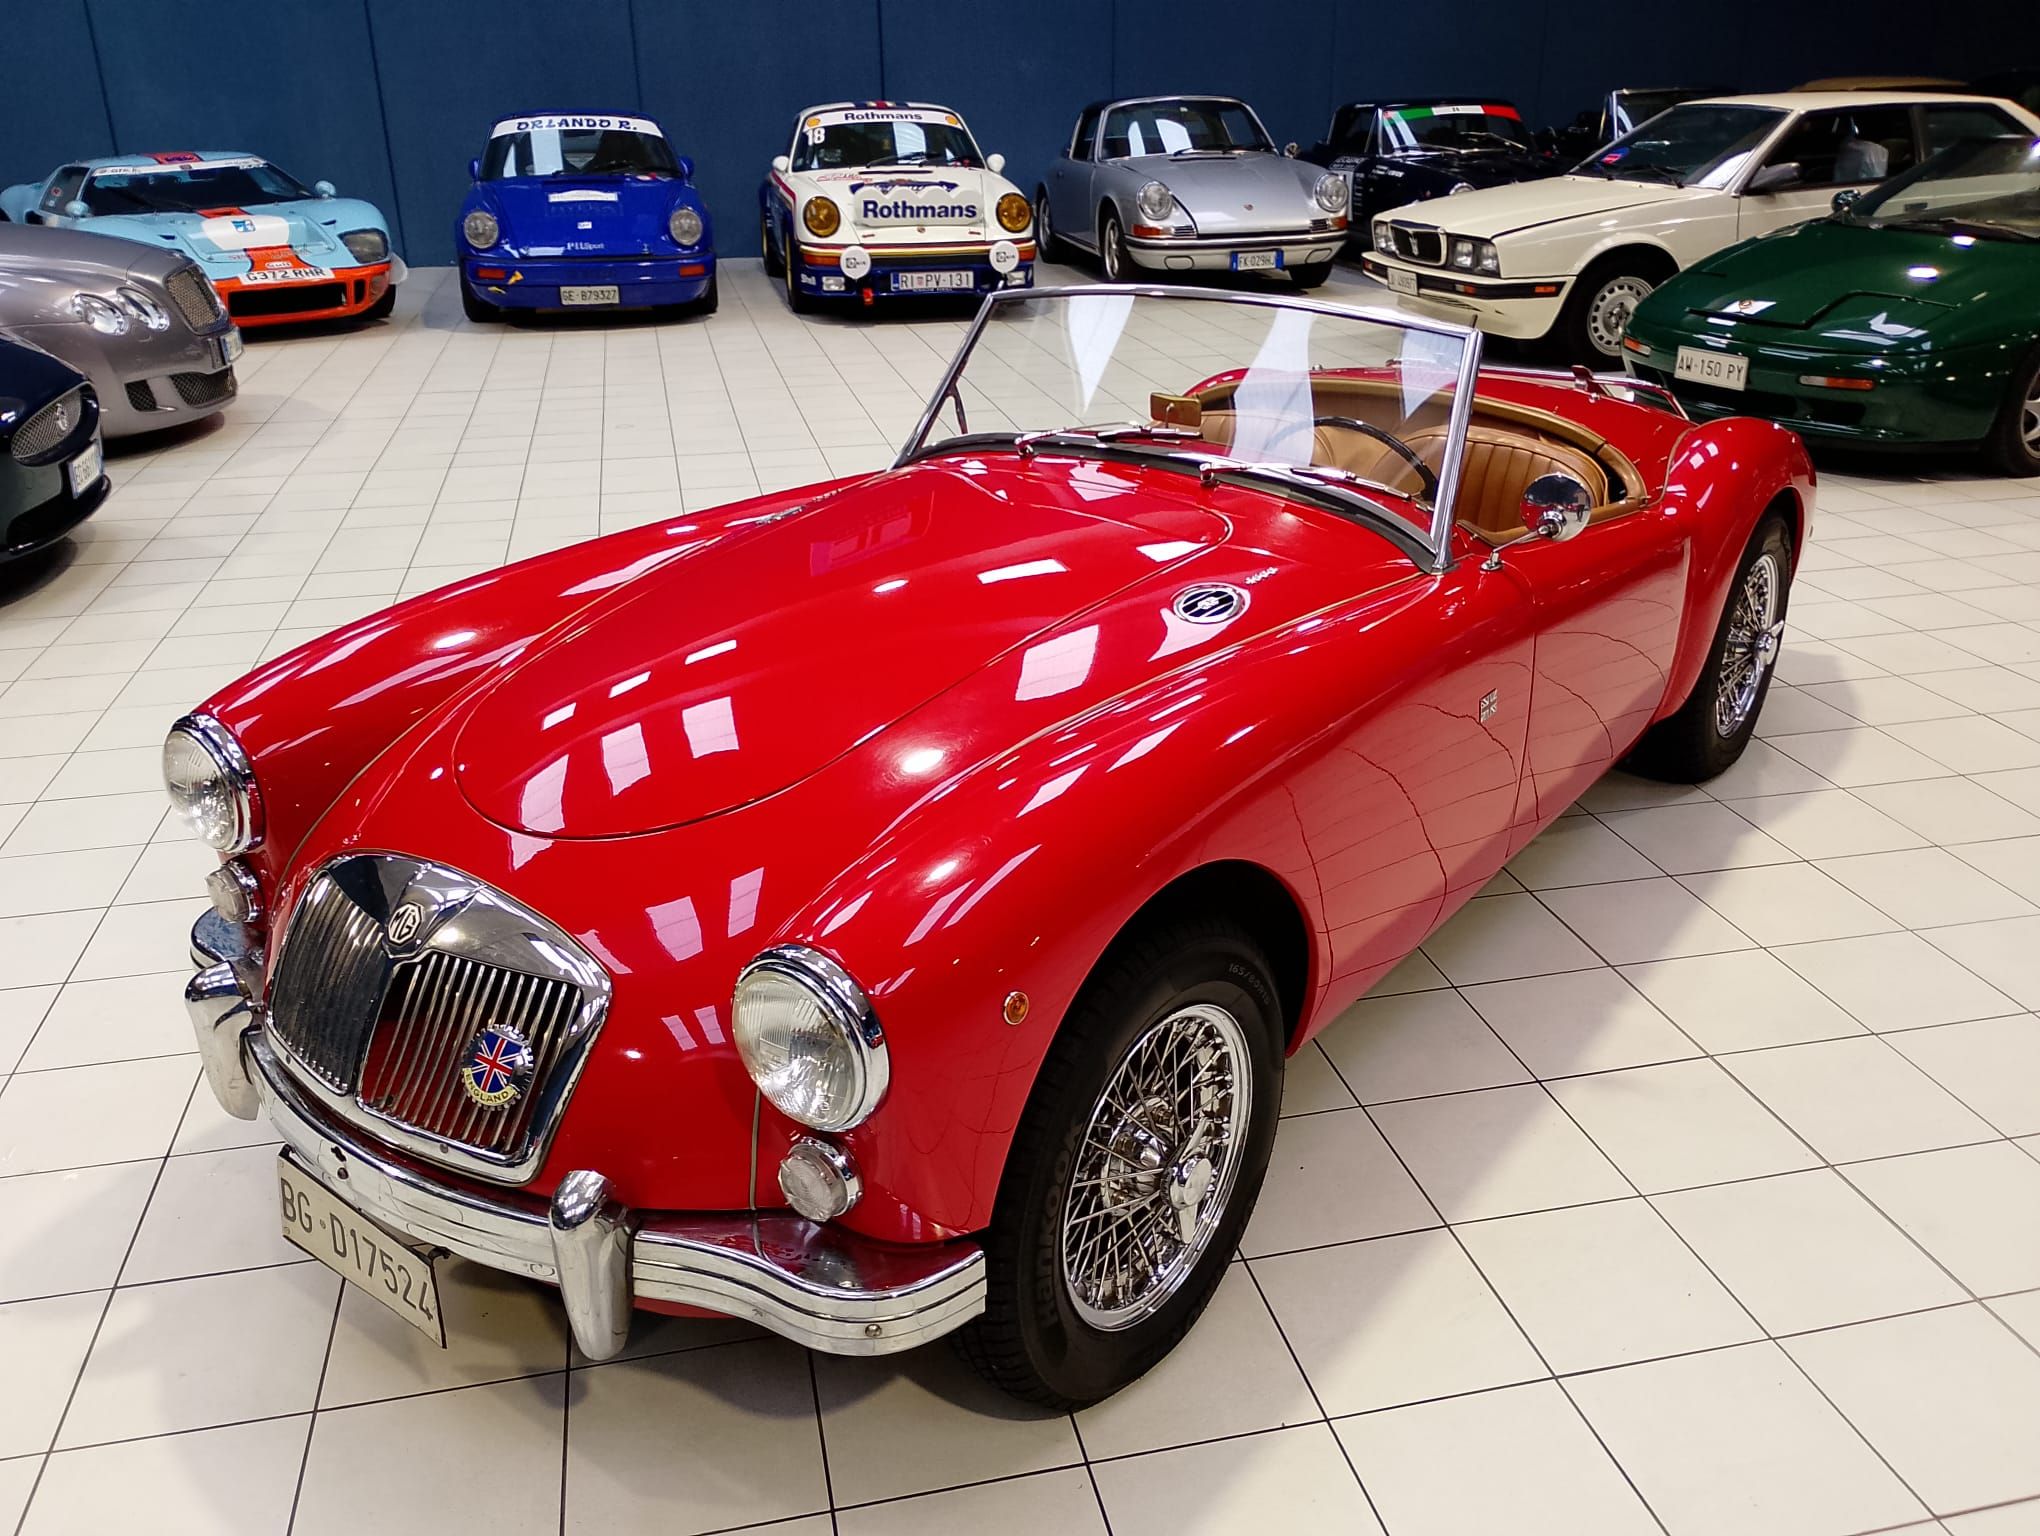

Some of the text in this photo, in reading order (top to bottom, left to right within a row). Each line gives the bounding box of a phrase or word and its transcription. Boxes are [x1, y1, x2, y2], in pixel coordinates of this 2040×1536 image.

[517, 117, 611, 131] ORLANDO
[844, 111, 922, 121] Rothmans
[806, 126, 825, 147] 18
[862, 199, 977, 219] Rothmans
[246, 269, 290, 282] G372
[1727, 363, 1744, 382] PY
[390, 906, 417, 940] MG
[465, 1072, 509, 1103] ENGLAND
